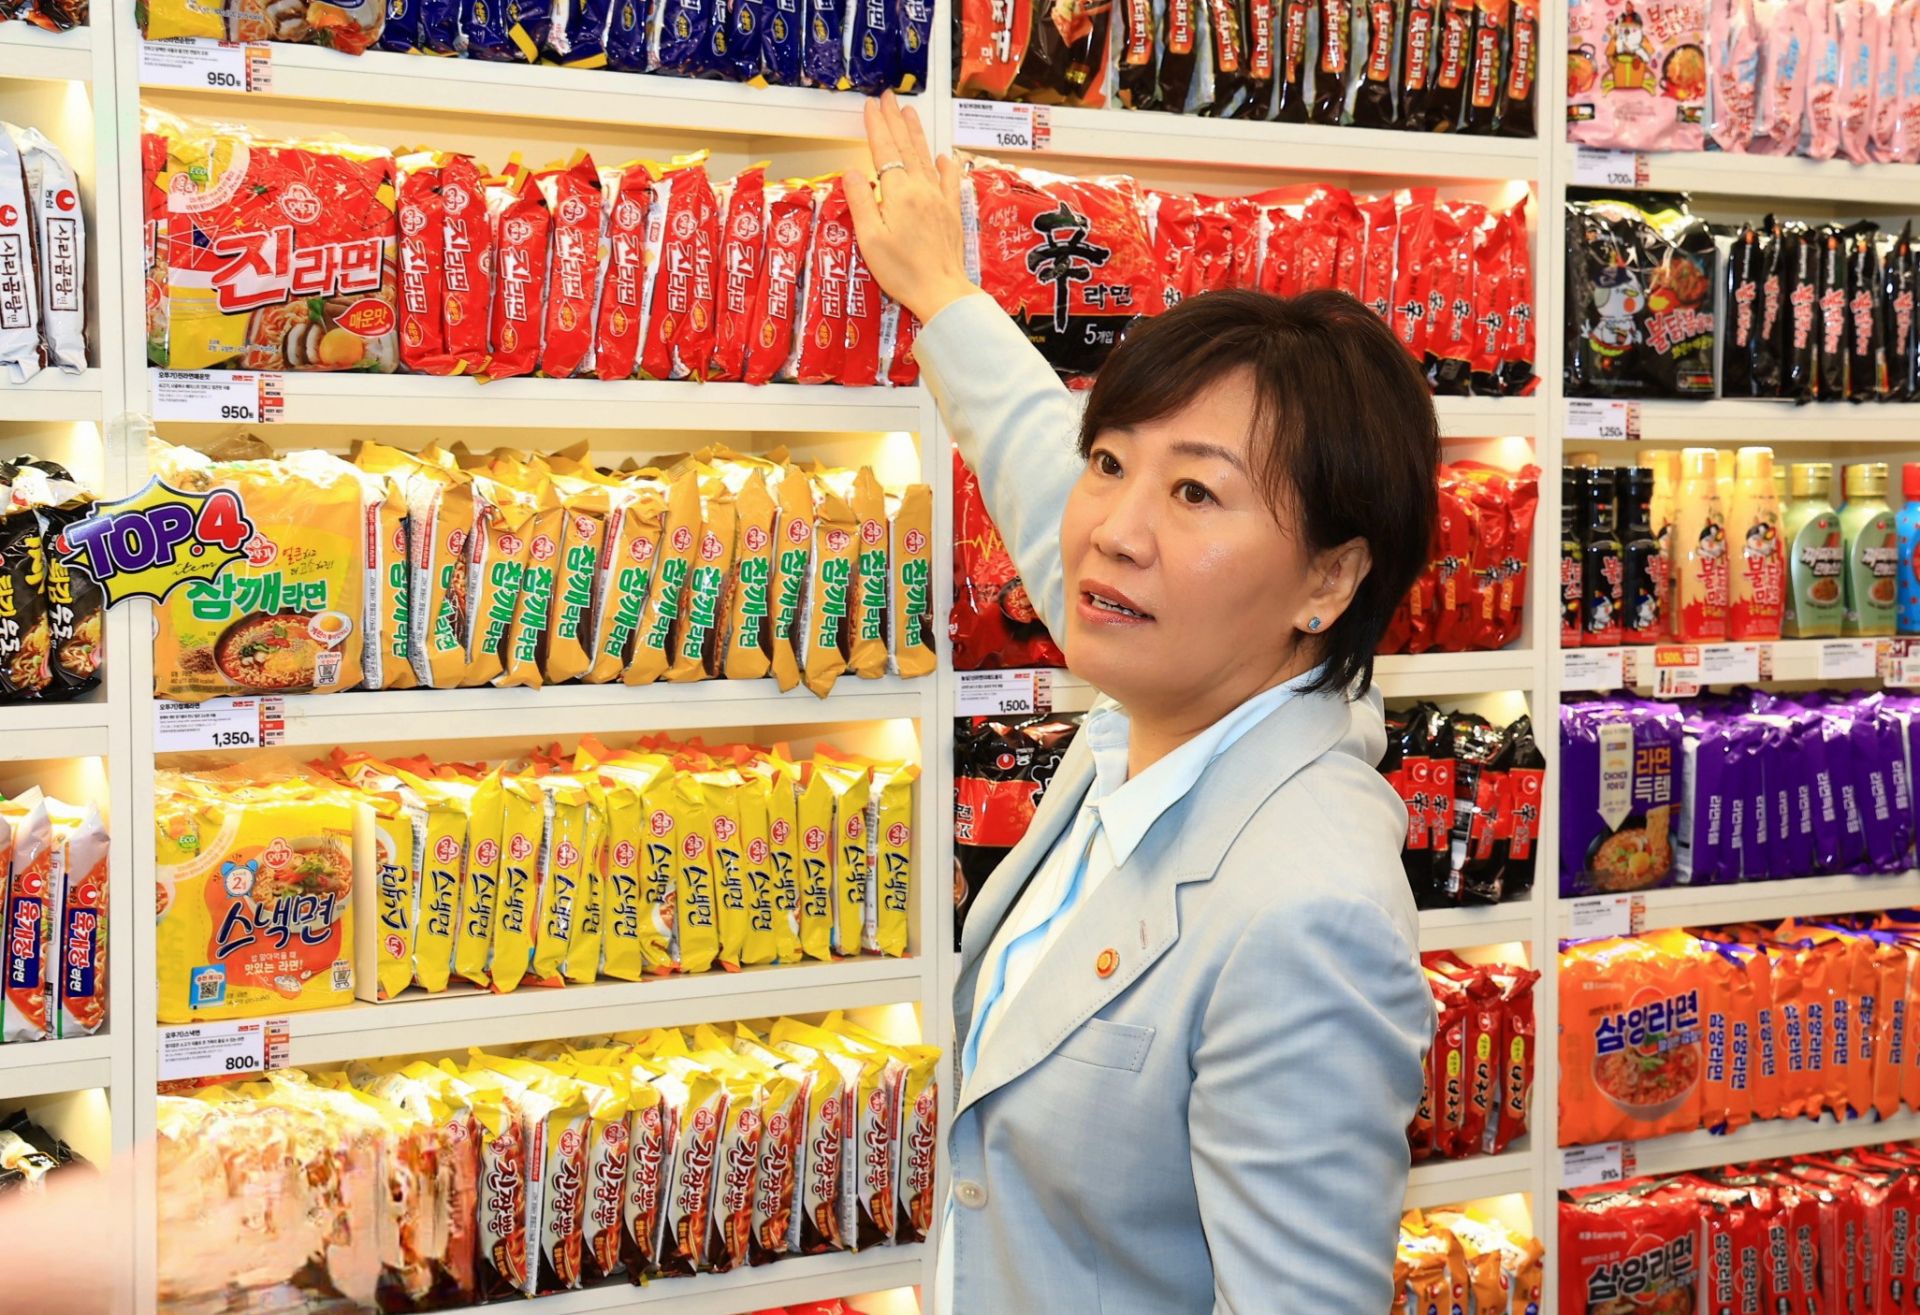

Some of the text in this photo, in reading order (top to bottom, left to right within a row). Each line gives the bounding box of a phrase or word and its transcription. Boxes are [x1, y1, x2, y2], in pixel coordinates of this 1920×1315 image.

[212, 225, 383, 314] 진라면
[403, 238, 429, 313] 진라면
[443, 217, 470, 291] 진라면
[500, 246, 531, 321] 진라면
[555, 227, 585, 299] 진라면
[612, 233, 639, 306] 진라면
[667, 241, 693, 313] 진라면
[727, 241, 754, 314] 진라면
[768, 247, 796, 319] 진라면
[819, 247, 847, 318] 진라면
[1025, 201, 1111, 333] 辛
[350, 308, 388, 329] 매운맛
[1083, 284, 1133, 309] 라면
[67, 494, 250, 578] TOP 4
[173, 560, 217, 576] item
[482, 561, 522, 654] 참깨라면
[515, 566, 552, 662] 참깨라면
[558, 545, 595, 639] 참깨라면
[603, 566, 648, 658] 참깨라면
[648, 557, 688, 649] 참깨라면
[683, 566, 721, 659] 참깨라면
[739, 557, 768, 648] 참깨라면
[776, 550, 807, 640] 참깨라면
[819, 557, 850, 648] 참깨라면
[859, 550, 886, 641] 참깨라면
[902, 559, 931, 648] 참깨라면
[381, 864, 409, 930] 스낵면
[429, 870, 456, 937] 스낵면
[469, 873, 495, 938] 스낵면
[502, 867, 529, 932] 스낵면
[548, 875, 575, 941] 스낵면
[613, 874, 639, 939] 스낵면
[646, 843, 672, 904] 스낵면
[683, 866, 713, 927] 스낵면
[717, 848, 744, 909] 스낵면
[748, 871, 773, 932] 스낵면
[771, 851, 798, 910] 스낵면
[804, 858, 827, 917] 스낵면
[885, 852, 909, 912] 스낵면
[12, 901, 41, 983] 육개장 라면
[67, 912, 96, 993] 육개장 라면
[216, 892, 336, 959] 스낵면
[244, 961, 275, 976] 맛있는
[1595, 989, 1699, 1055] 삼양라면
[1707, 1012, 1726, 1081] 삼양라면
[1731, 1021, 1749, 1090] 삼양라면
[1759, 1009, 1775, 1077] 삼양라면
[1783, 1004, 1803, 1072] 삼양라면
[1807, 1003, 1823, 1071] 삼양라면
[1833, 999, 1849, 1066] 삼양라면
[593, 1151, 627, 1228] 진짬뽕
[633, 1134, 663, 1210] 진짬뽕
[680, 1138, 712, 1213] 진짬뽕
[725, 1140, 757, 1213] 진짬뽕
[759, 1143, 788, 1217] 진짬뽕
[813, 1128, 840, 1202] 진짬뽕
[865, 1118, 889, 1190] 진짬뽕
[909, 1121, 934, 1192] 진짬뽕
[489, 1159, 518, 1236] 진짬뽕
[553, 1160, 580, 1237] 진짬뽕
[1587, 1231, 1695, 1304] 삼양라면
[1714, 1232, 1732, 1304] 삼양라면
